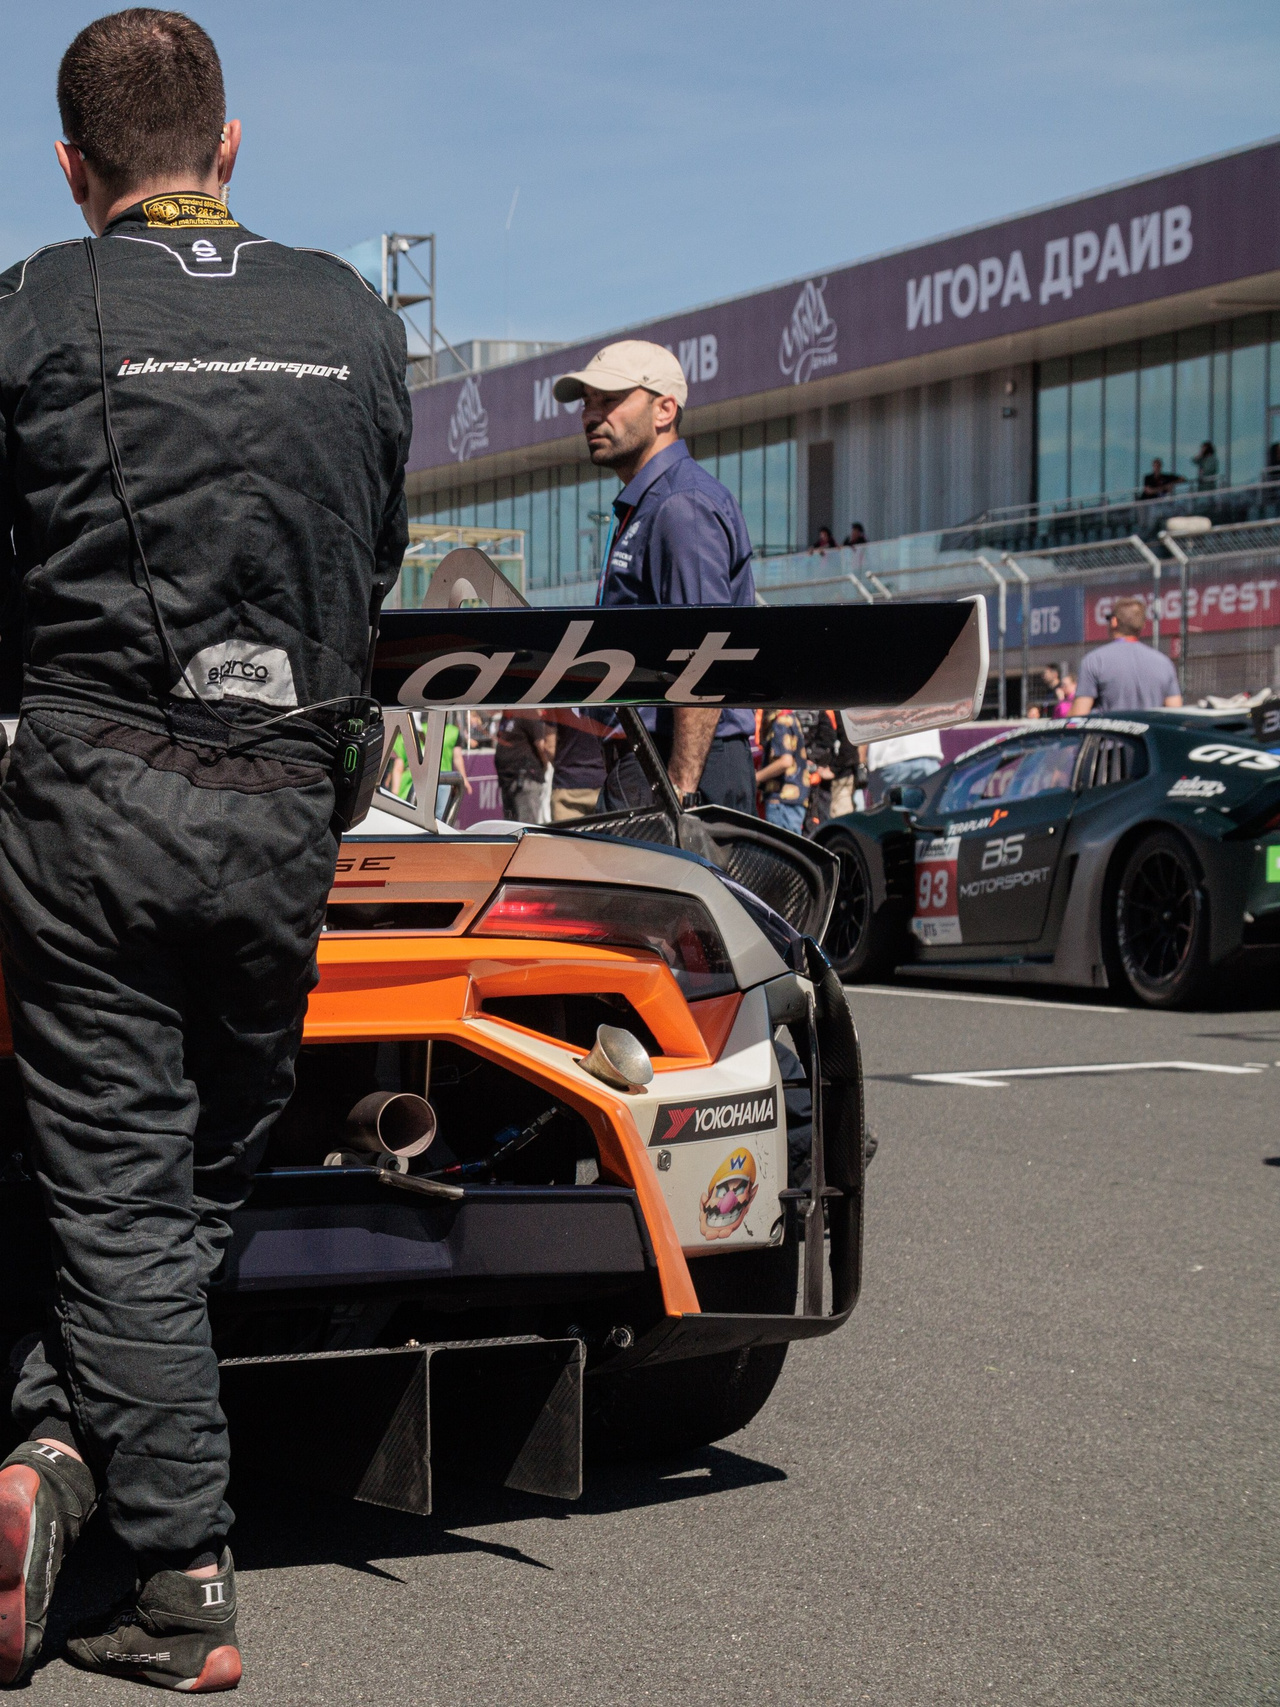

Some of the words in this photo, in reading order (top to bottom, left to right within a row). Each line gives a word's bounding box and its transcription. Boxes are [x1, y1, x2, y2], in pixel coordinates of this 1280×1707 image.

[906, 250, 1032, 331] ИГОРА
[1039, 204, 1193, 305] ДРАЙВ
[117, 357, 188, 377] iskra
[206, 357, 351, 381] motorsport
[1030, 606, 1061, 636] ВТБ
[207, 660, 269, 685] sparco
[918, 870, 949, 909] 93
[960, 867, 1051, 898] MOTORSPORT
[695, 1098, 774, 1133] YOKOHAMA
[106, 1651, 171, 1663] PORSCHE
